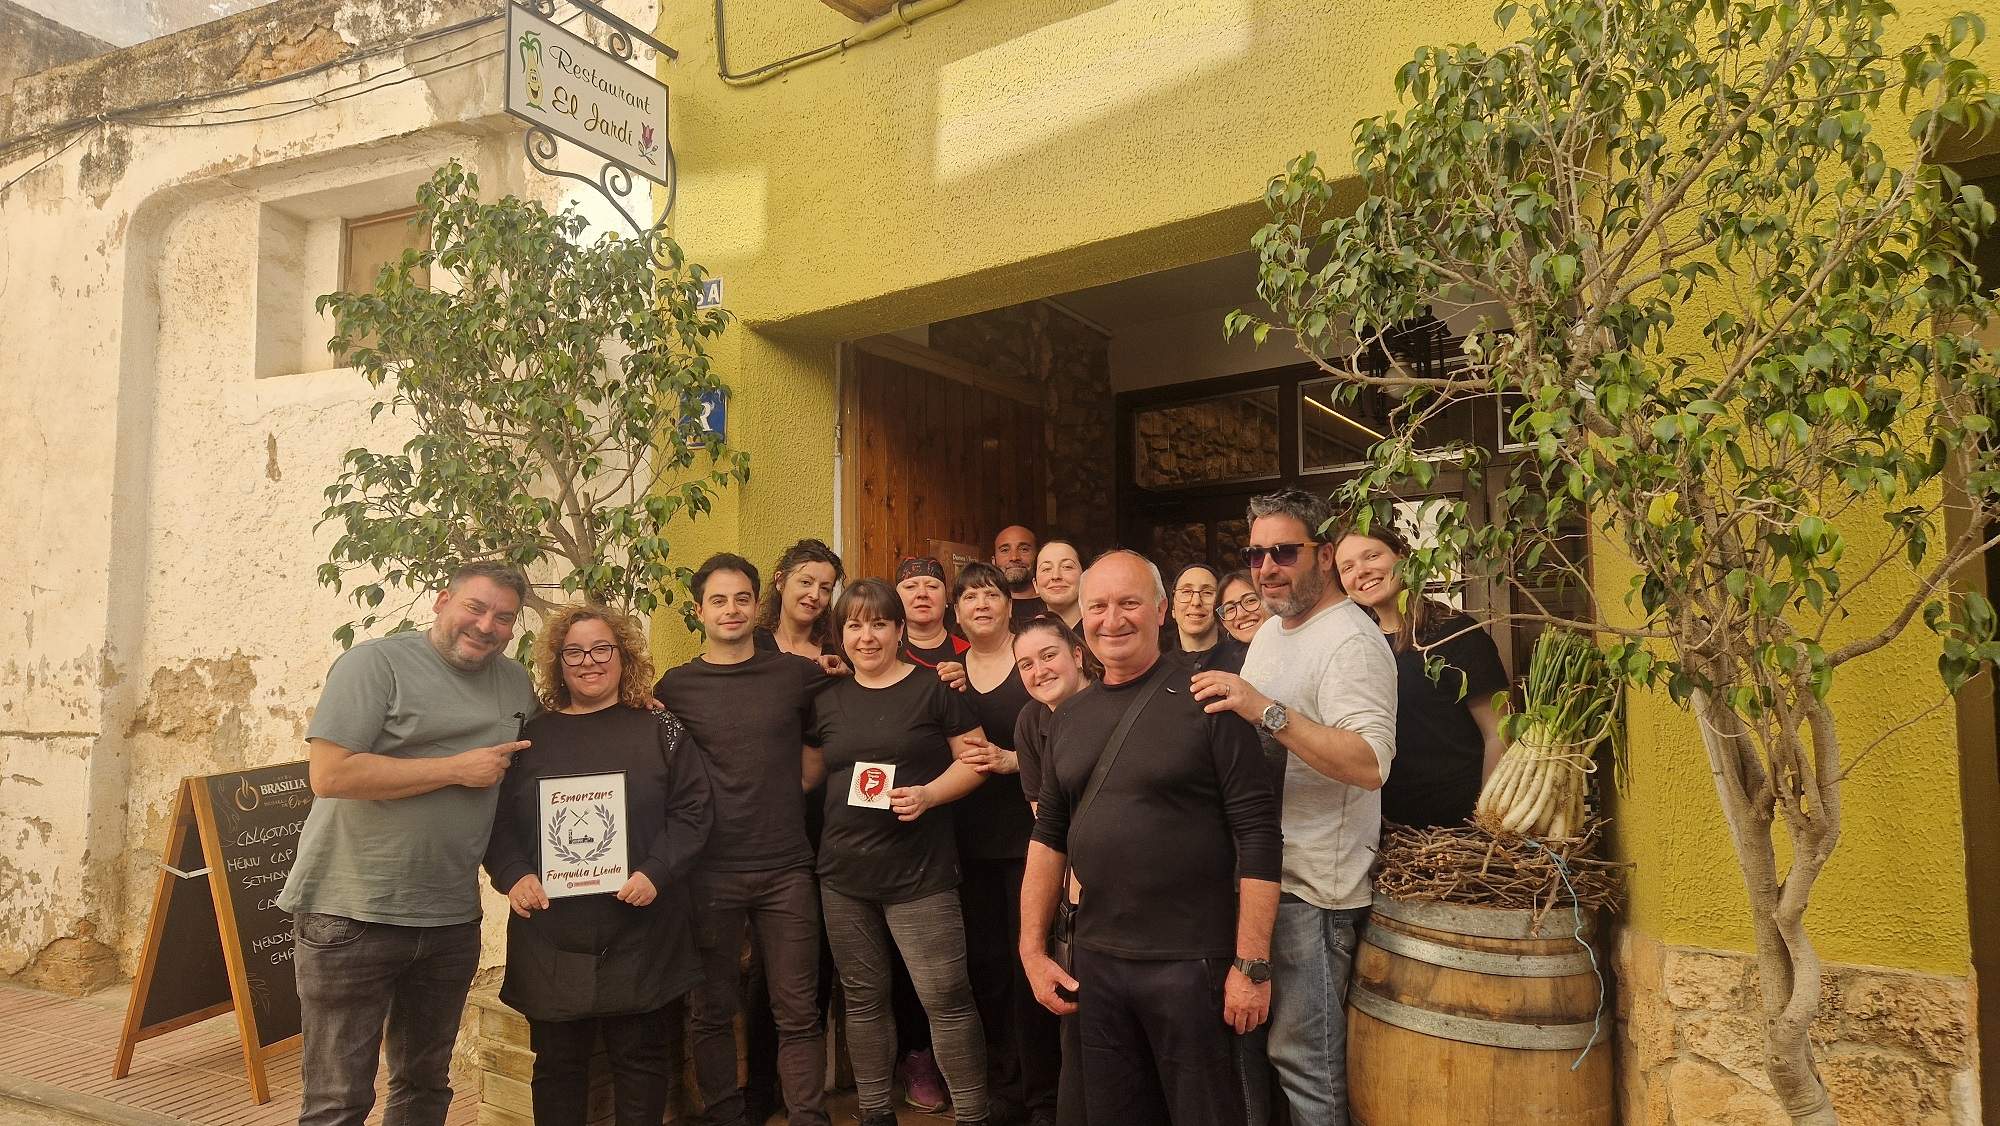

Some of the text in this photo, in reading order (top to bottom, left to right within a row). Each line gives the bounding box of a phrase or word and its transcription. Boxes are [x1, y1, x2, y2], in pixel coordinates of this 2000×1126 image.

[549, 45, 651, 114] Restaurant
[552, 86, 578, 120] El
[260, 778, 308, 795] BRASILIA
[551, 790, 614, 805] Esmorzars
[236, 820, 304, 846] CALÇOTADE
[270, 848, 294, 864] CAP
[242, 870, 291, 889] SETMAN
[546, 863, 622, 882] Forquilla Lleida
